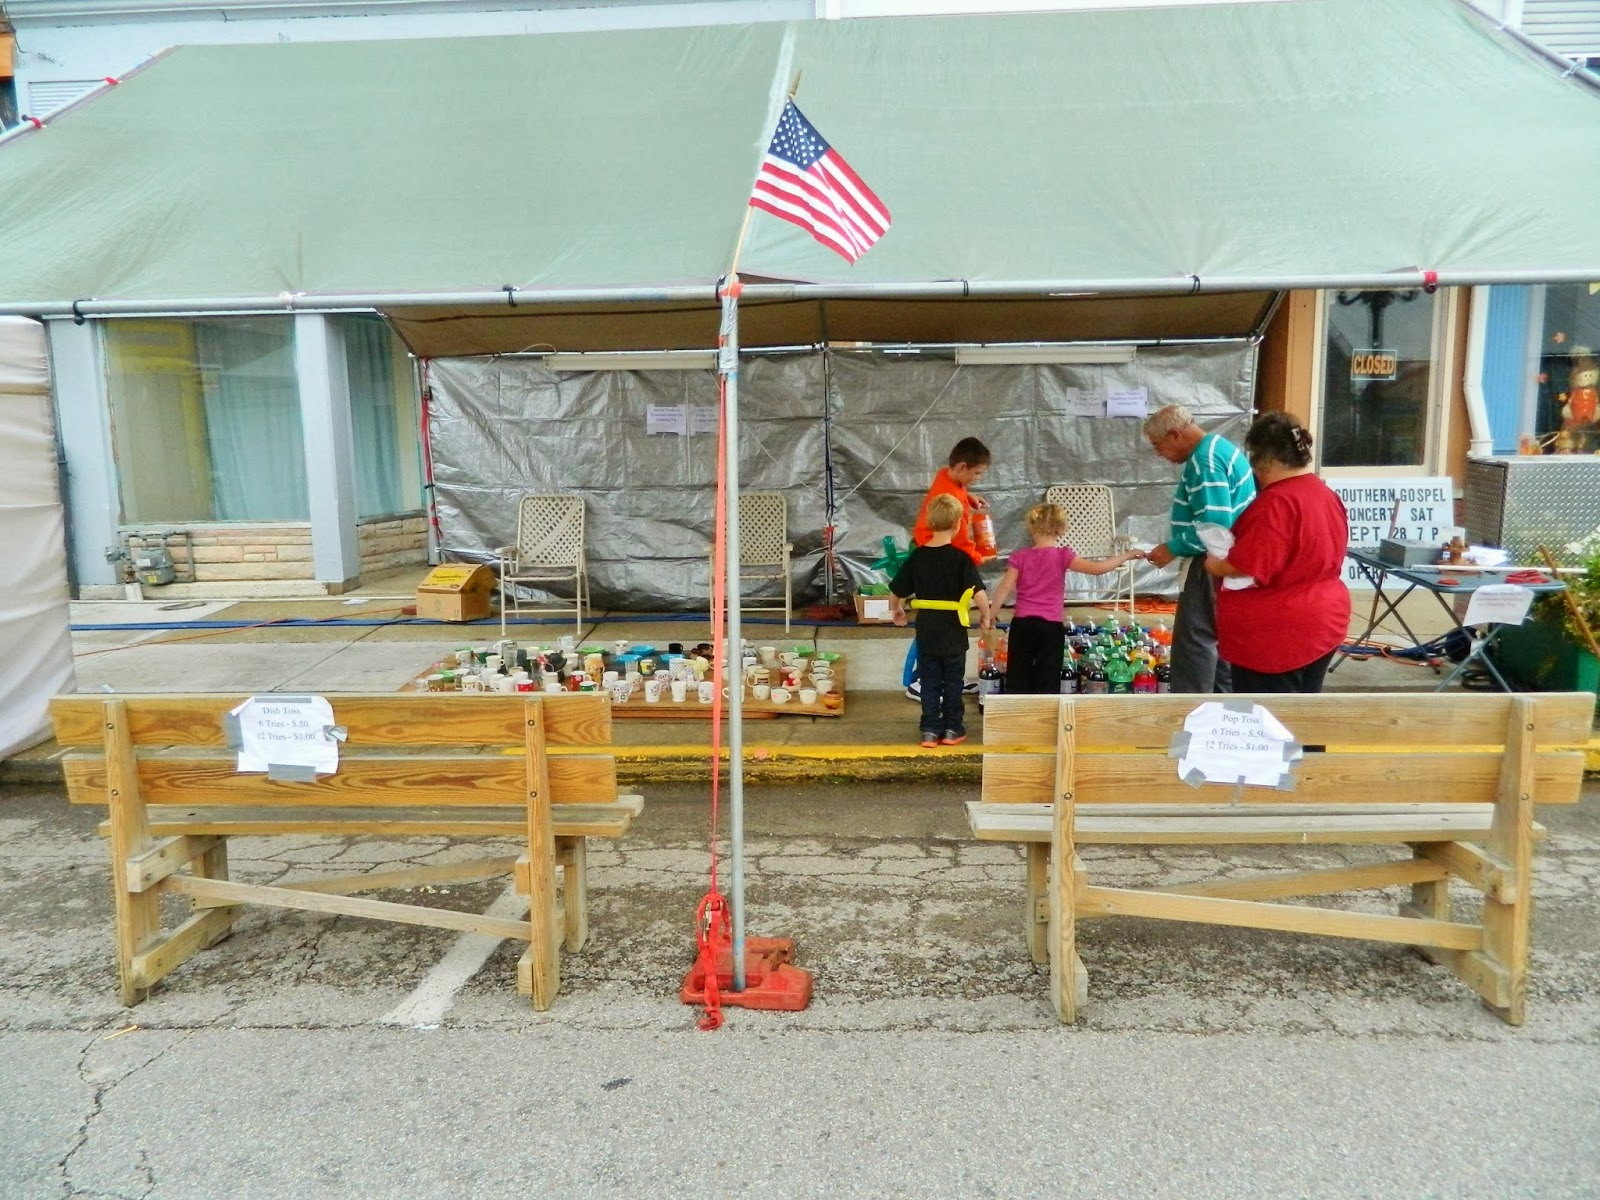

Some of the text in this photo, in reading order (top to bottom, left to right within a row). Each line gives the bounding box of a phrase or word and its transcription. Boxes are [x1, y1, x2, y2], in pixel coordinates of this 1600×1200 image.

[1353, 354, 1395, 375] CLOSED
[1400, 488, 1446, 502] GOSPEL
[1346, 507, 1433, 521] ONCERT SAT
[1349, 526, 1380, 541] EPT
[1393, 527, 1407, 540] 28
[1417, 527, 1423, 540] 7
[263, 707, 301, 715] Dish Toss
[266, 720, 285, 728] Tries
[1222, 714, 1260, 724] Pop Toss
[1220, 728, 1240, 737] Tries
[1205, 741, 1215, 749] 12
[1218, 741, 1238, 750] Tries
[1246, 742, 1269, 751] $1.00
